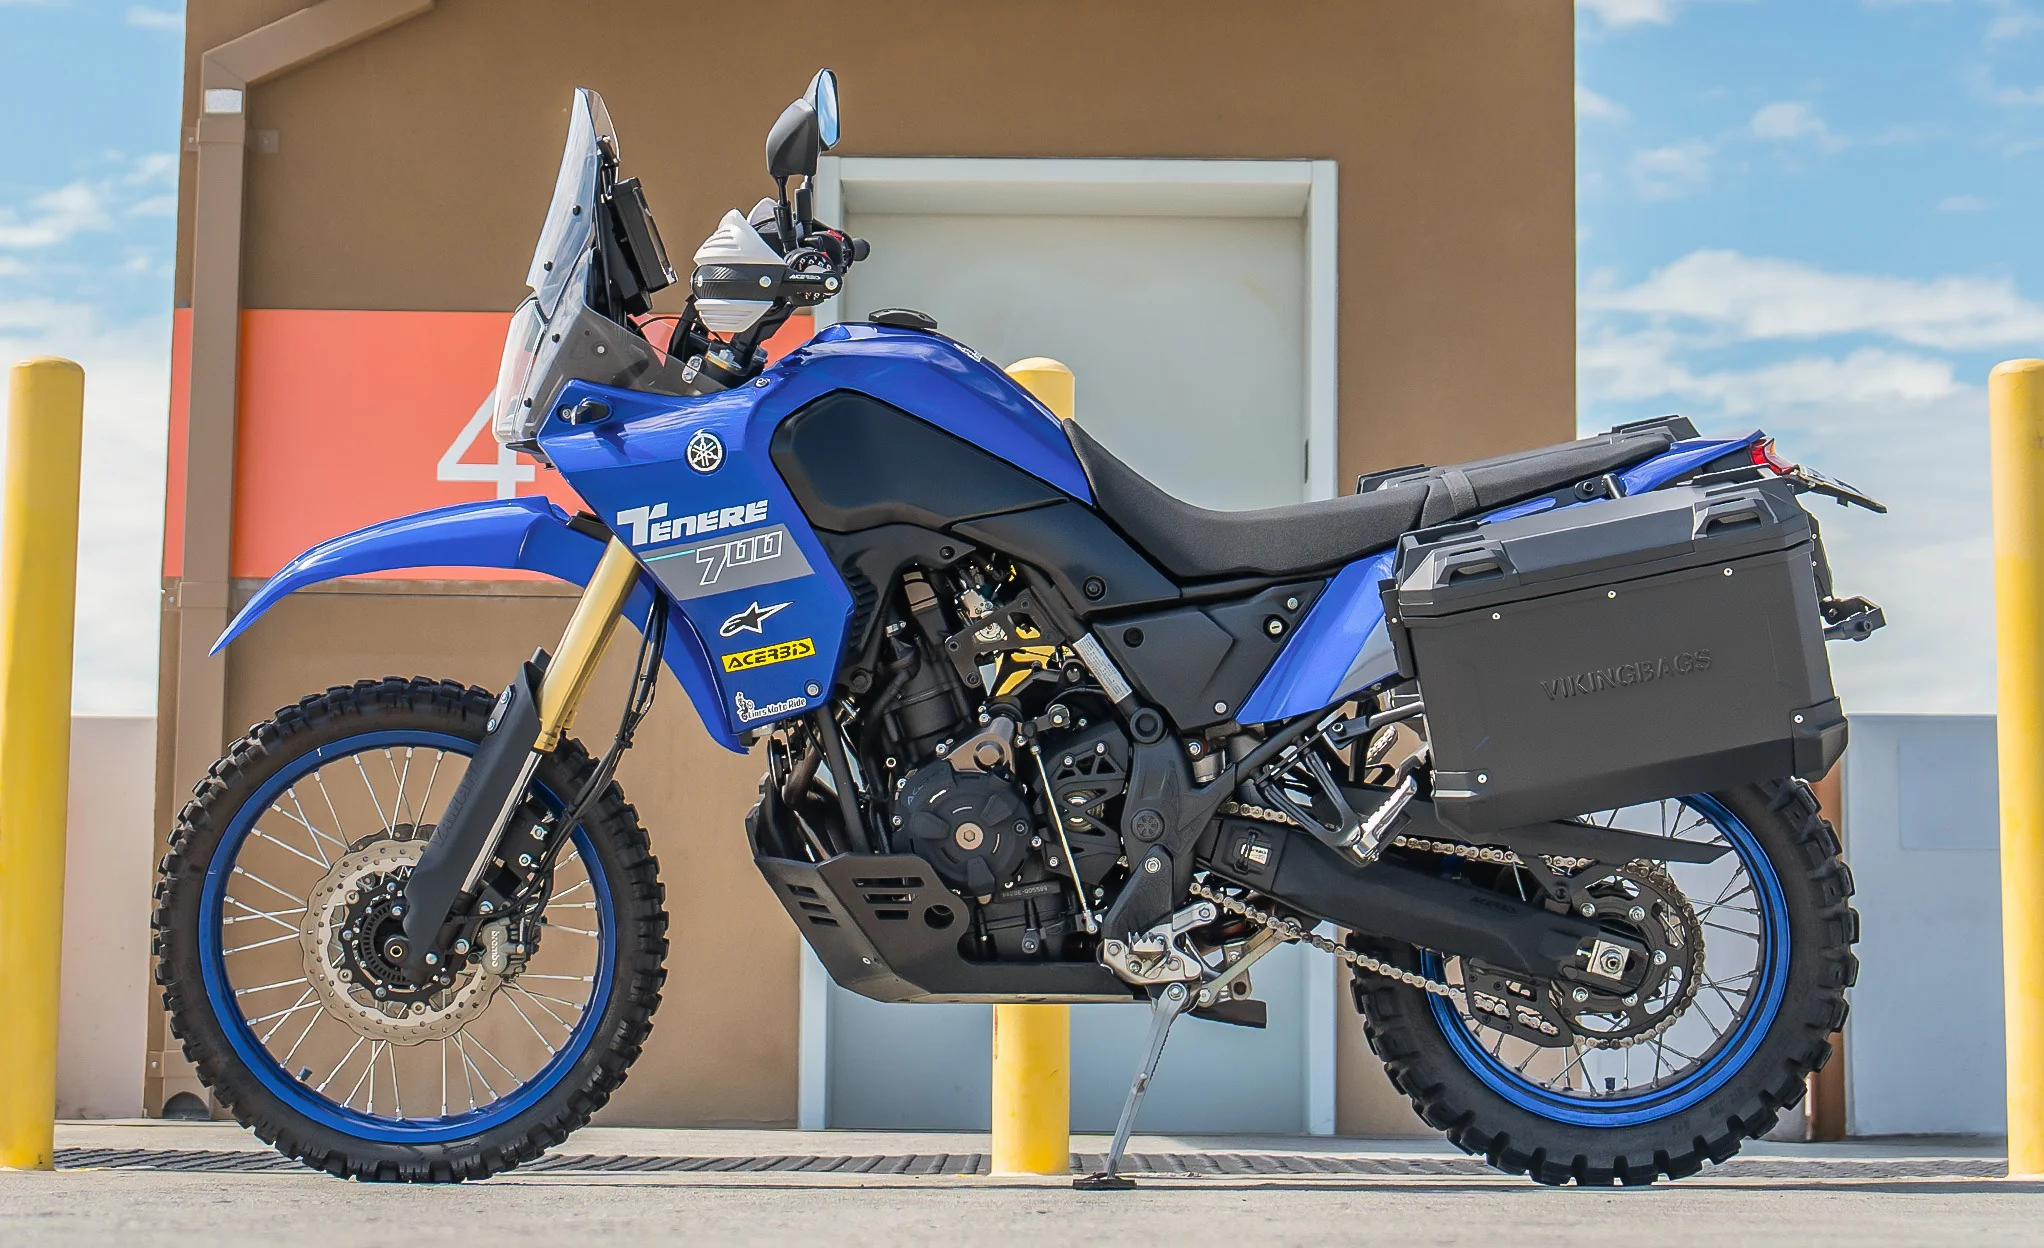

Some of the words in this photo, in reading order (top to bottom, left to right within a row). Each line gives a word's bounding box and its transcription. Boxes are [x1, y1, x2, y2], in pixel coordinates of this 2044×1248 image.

[437, 384, 535, 500] 4
[696, 530, 783, 586] 700
[728, 642, 811, 669] ACERBIS
[1539, 649, 1713, 701] VIKINGBAGS
[788, 698, 806, 709] Ride
[491, 930, 500, 968] brembo
